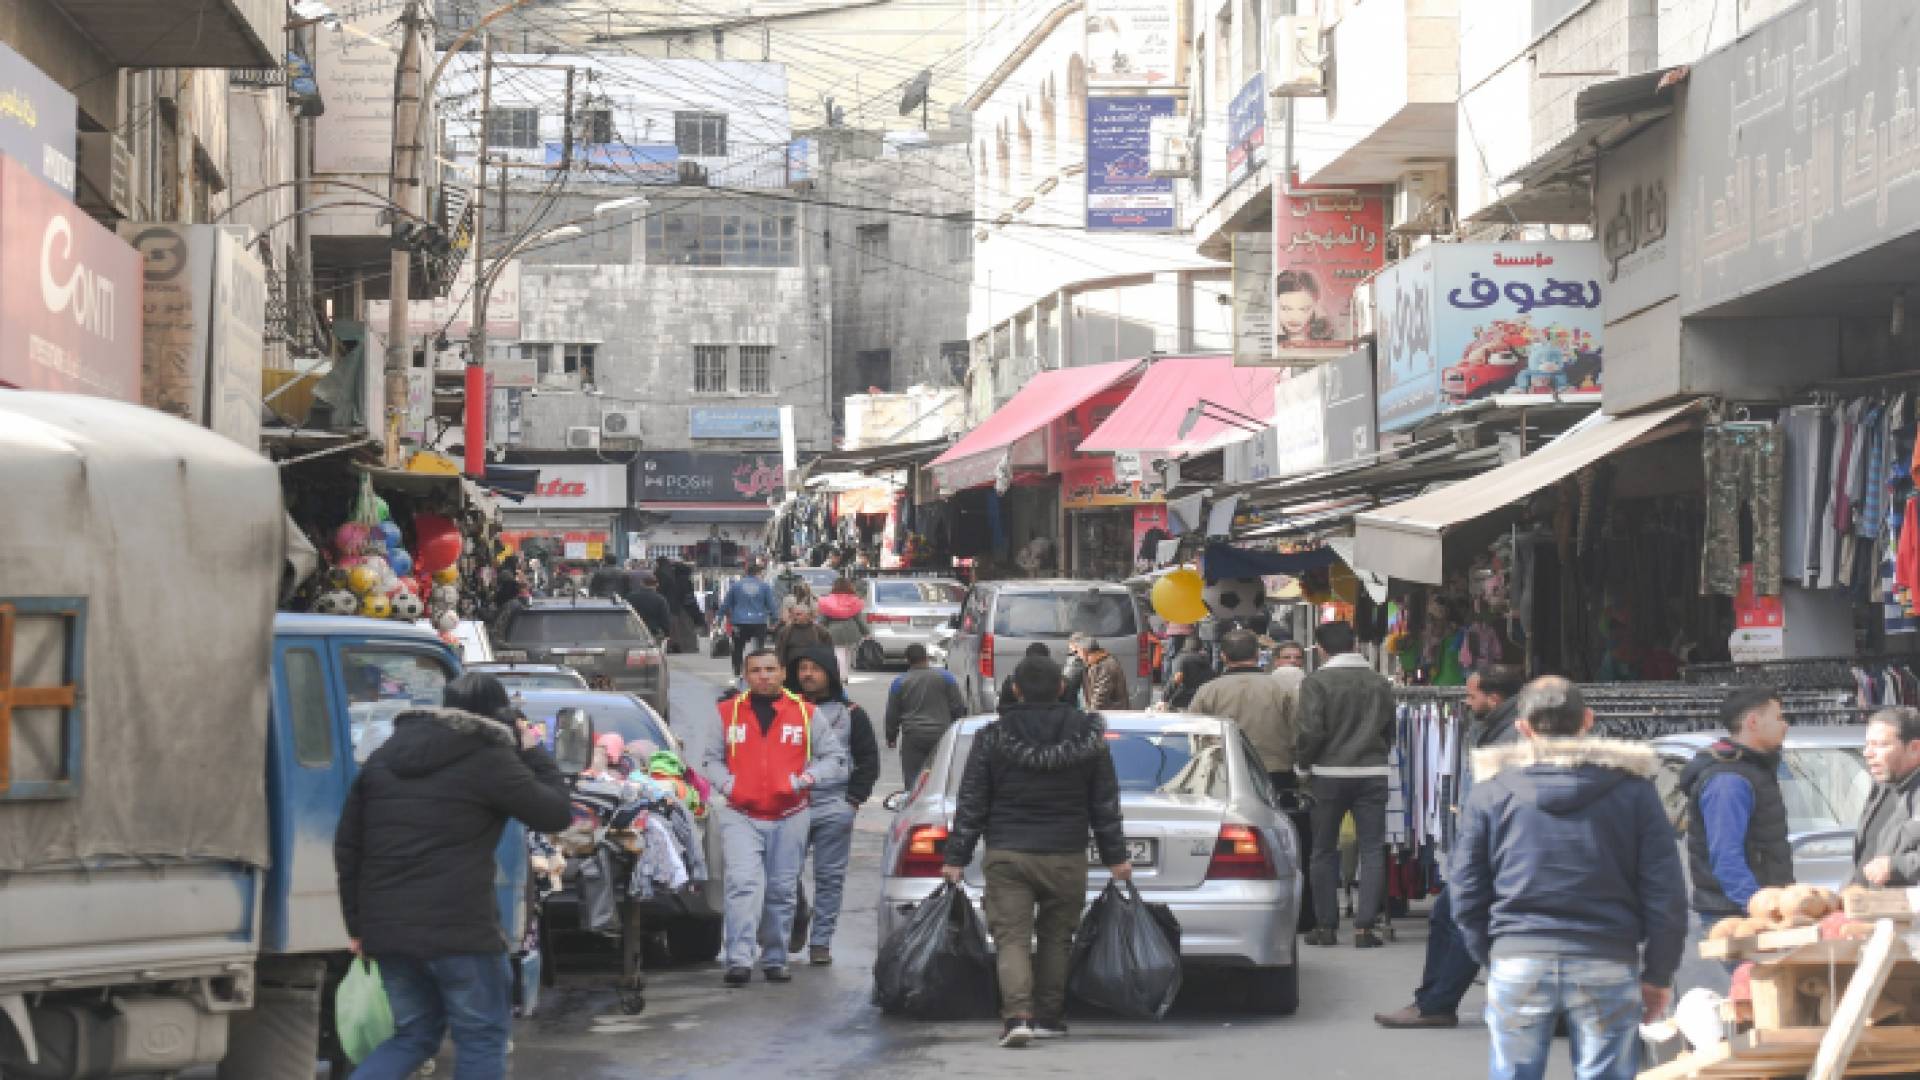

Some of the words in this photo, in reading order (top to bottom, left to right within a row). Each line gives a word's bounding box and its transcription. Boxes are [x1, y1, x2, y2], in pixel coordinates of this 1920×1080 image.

[1287, 223, 1377, 253] والمهجر
[1493, 251, 1554, 268] مؤسسة
[666, 474, 713, 489] POSH
